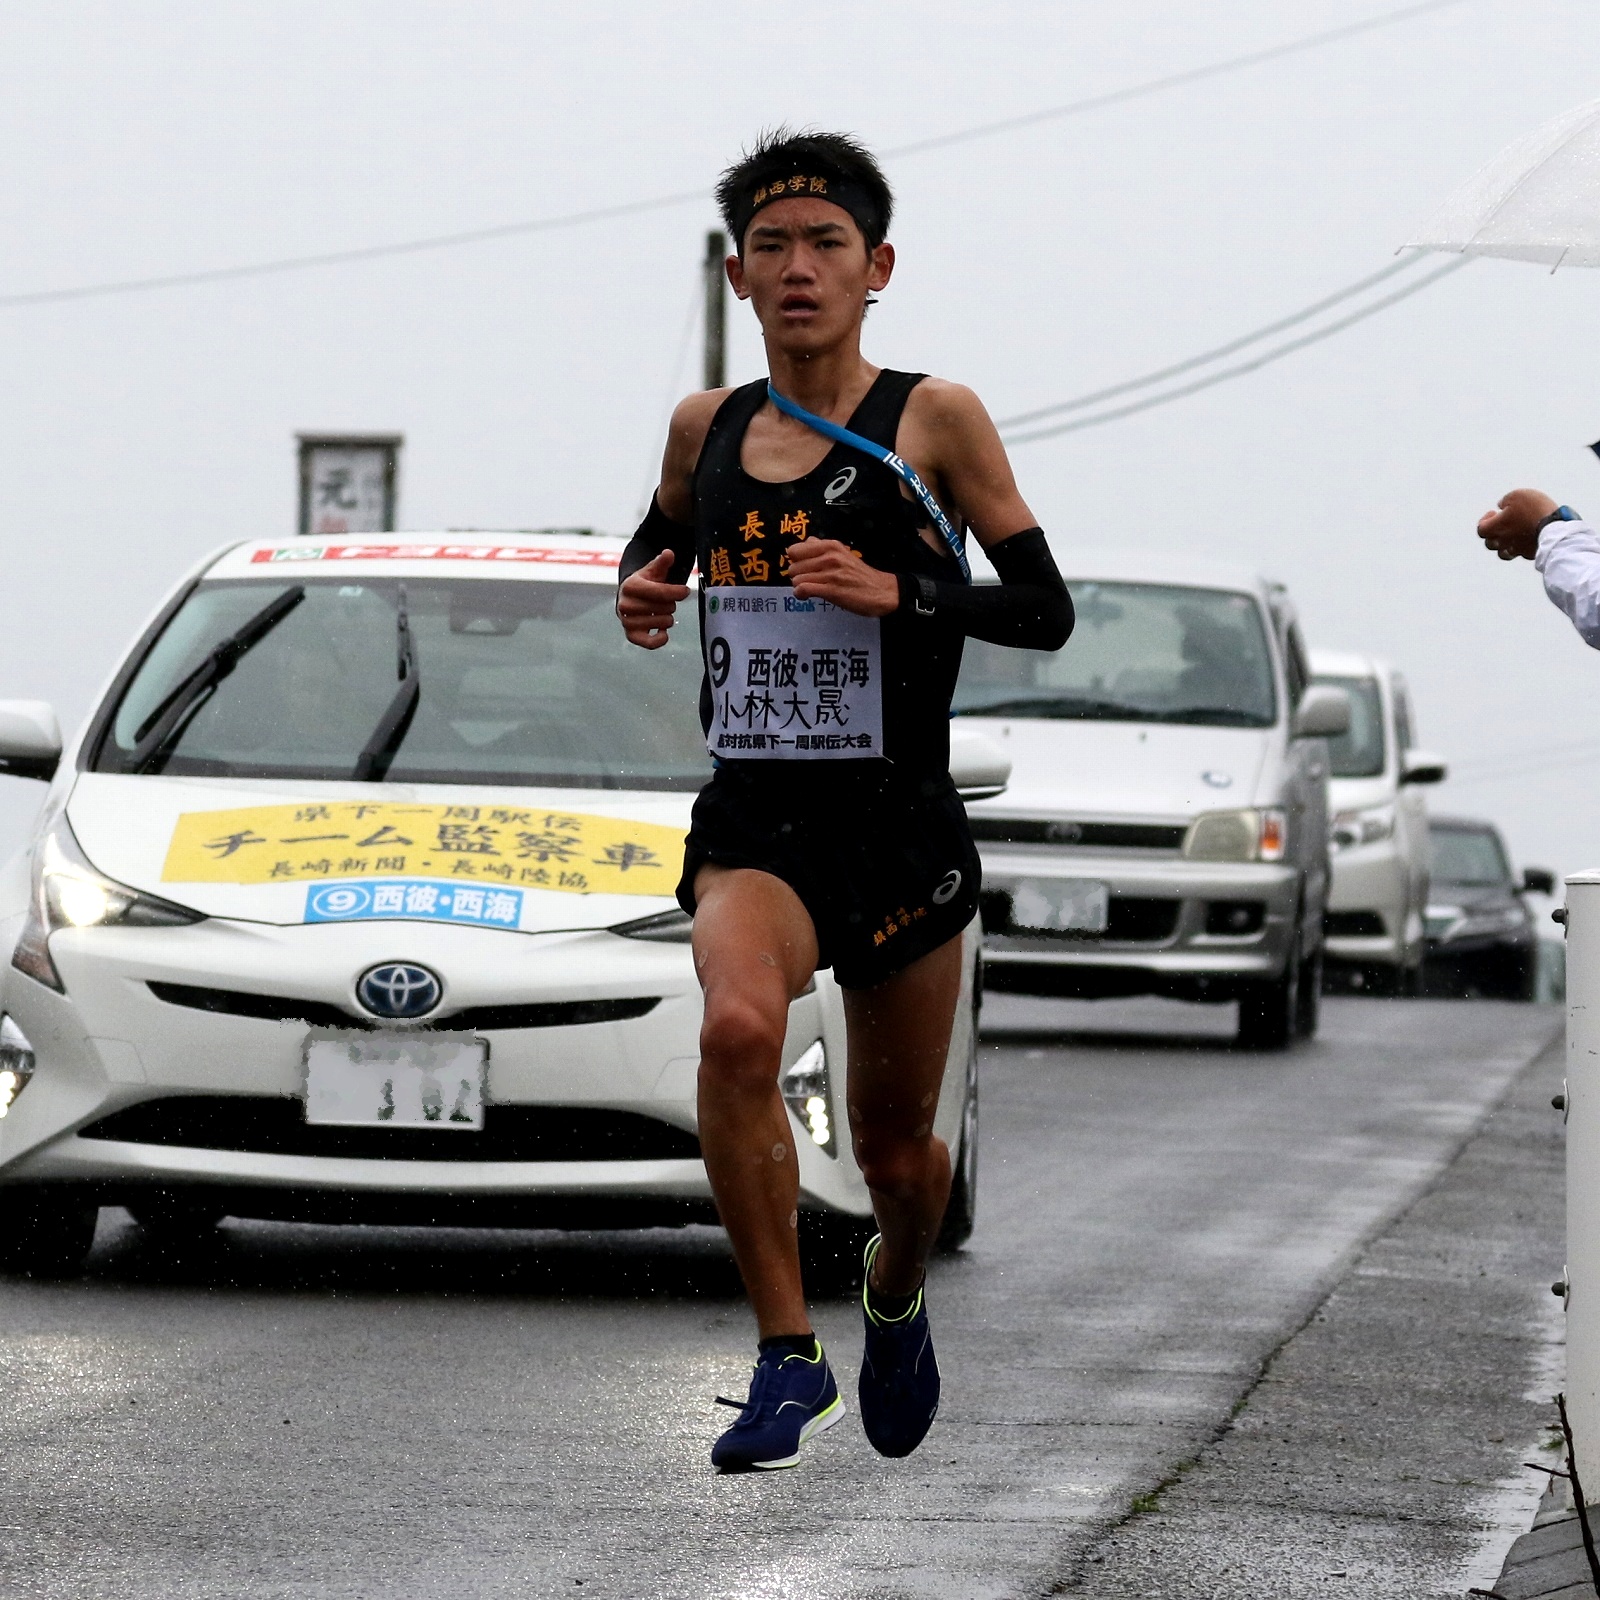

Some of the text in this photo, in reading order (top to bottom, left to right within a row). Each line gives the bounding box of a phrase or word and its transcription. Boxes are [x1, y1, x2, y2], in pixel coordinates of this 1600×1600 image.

[739, 510, 810, 542] 長崎
[722, 597, 777, 612] 親和銀行
[709, 637, 869, 688] 9 西彼・西海
[294, 804, 582, 831] 県下一周駅伝
[202, 823, 663, 872] チーム監察車
